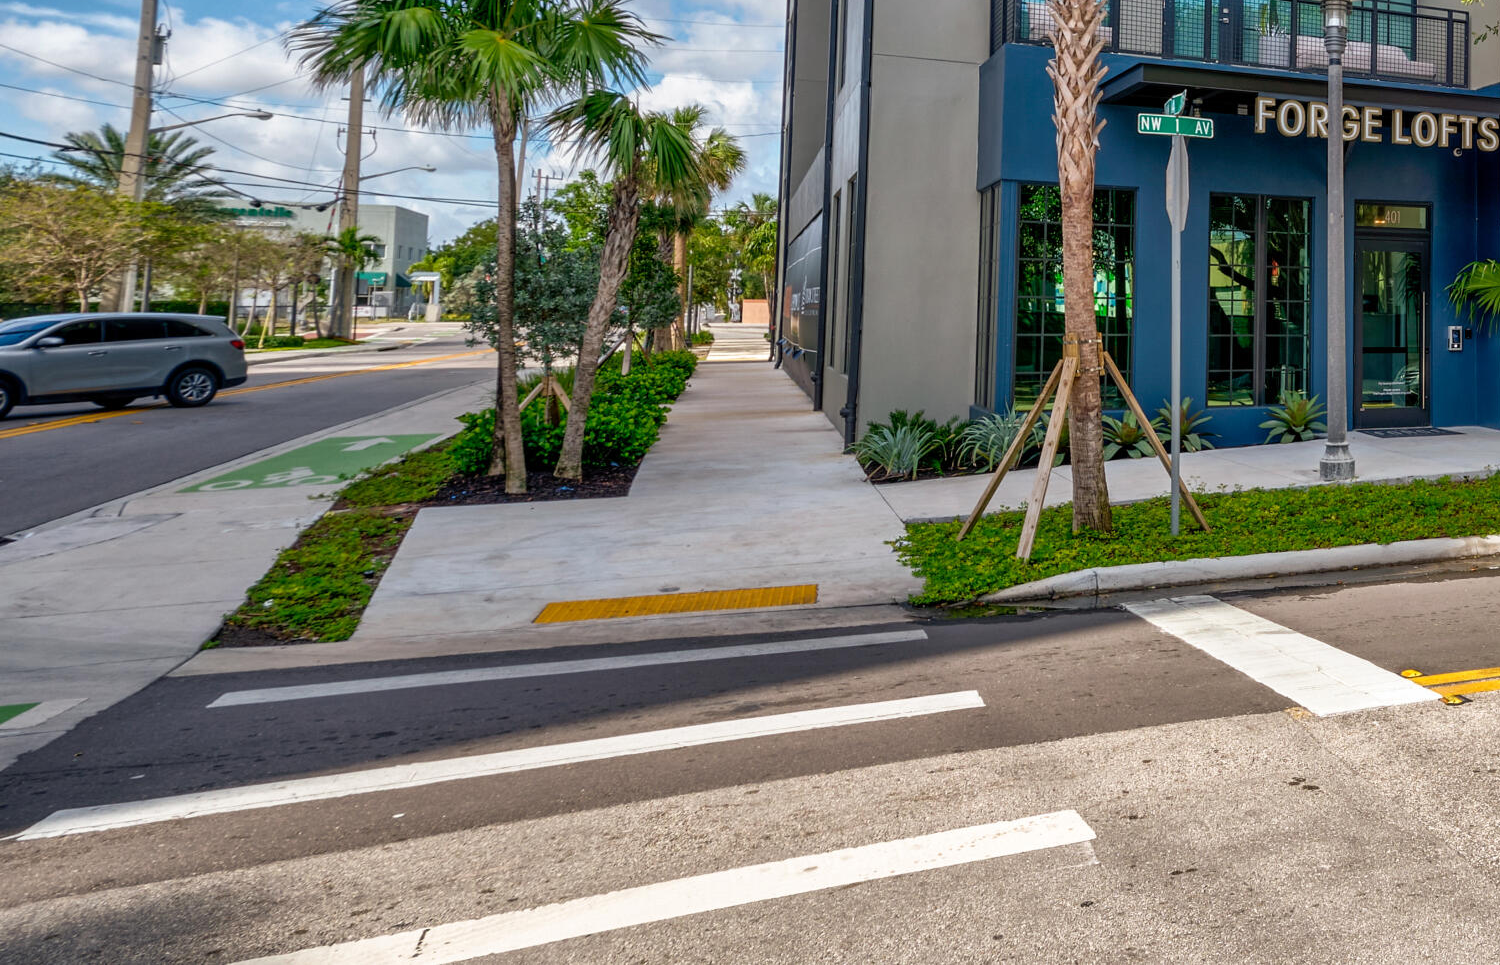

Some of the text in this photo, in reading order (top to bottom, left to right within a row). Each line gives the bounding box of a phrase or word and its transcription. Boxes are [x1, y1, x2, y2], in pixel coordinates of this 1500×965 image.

[1141, 116, 1210, 135] NW 1 AV
[1254, 96, 1500, 152] FORGE LOFTS
[1385, 209, 1401, 224] 401
